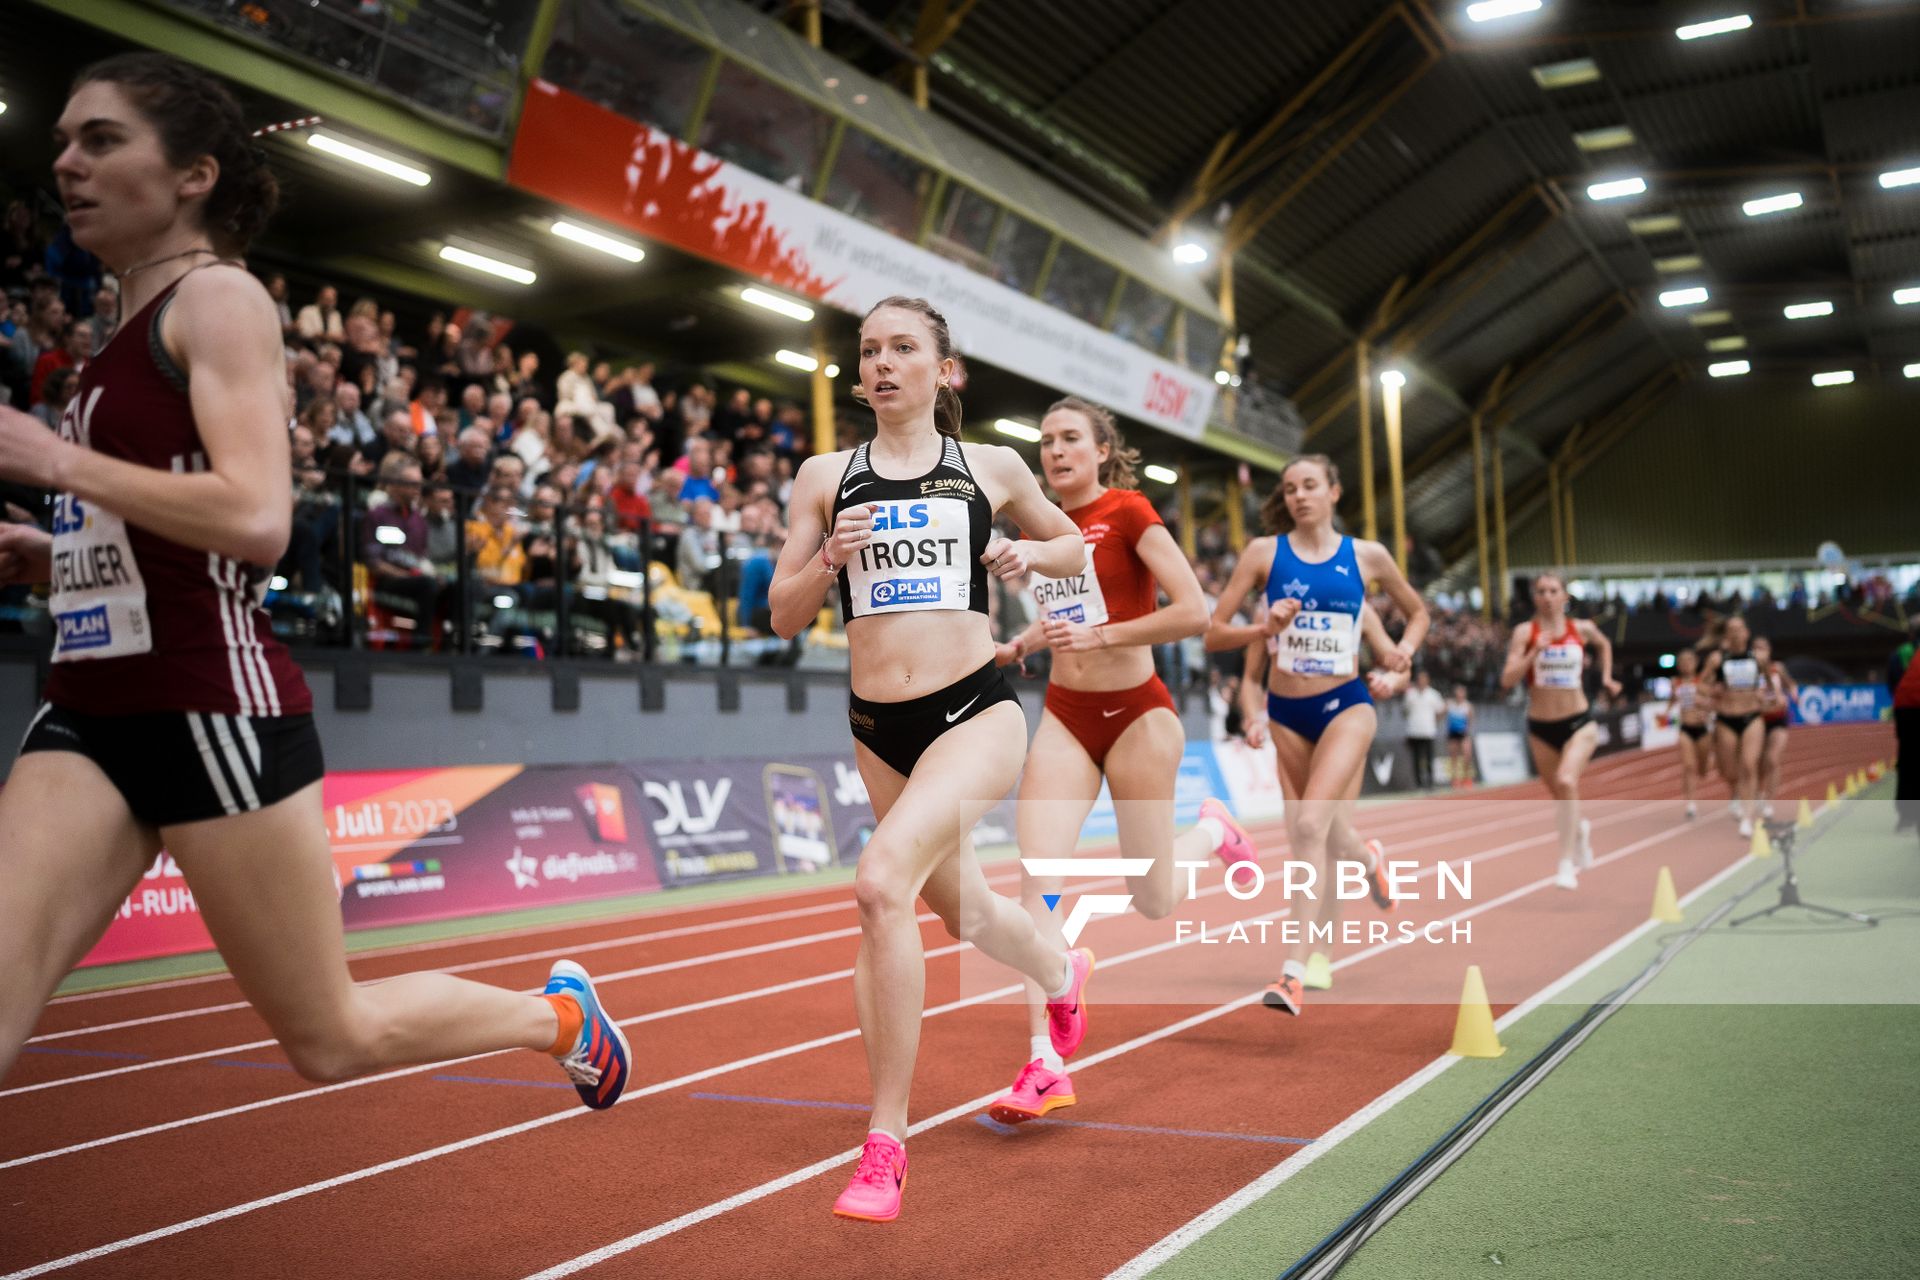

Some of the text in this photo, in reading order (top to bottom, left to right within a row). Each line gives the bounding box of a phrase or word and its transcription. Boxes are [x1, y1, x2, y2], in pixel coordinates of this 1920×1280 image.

[53, 543, 131, 594] TELLIER
[859, 538, 959, 571] TROST
[898, 582, 938, 594] PLAN
[1034, 574, 1089, 605] GRANZ
[63, 613, 105, 635] PLAN
[1288, 635, 1344, 653] MEISL
[335, 798, 458, 838] Juli 2023
